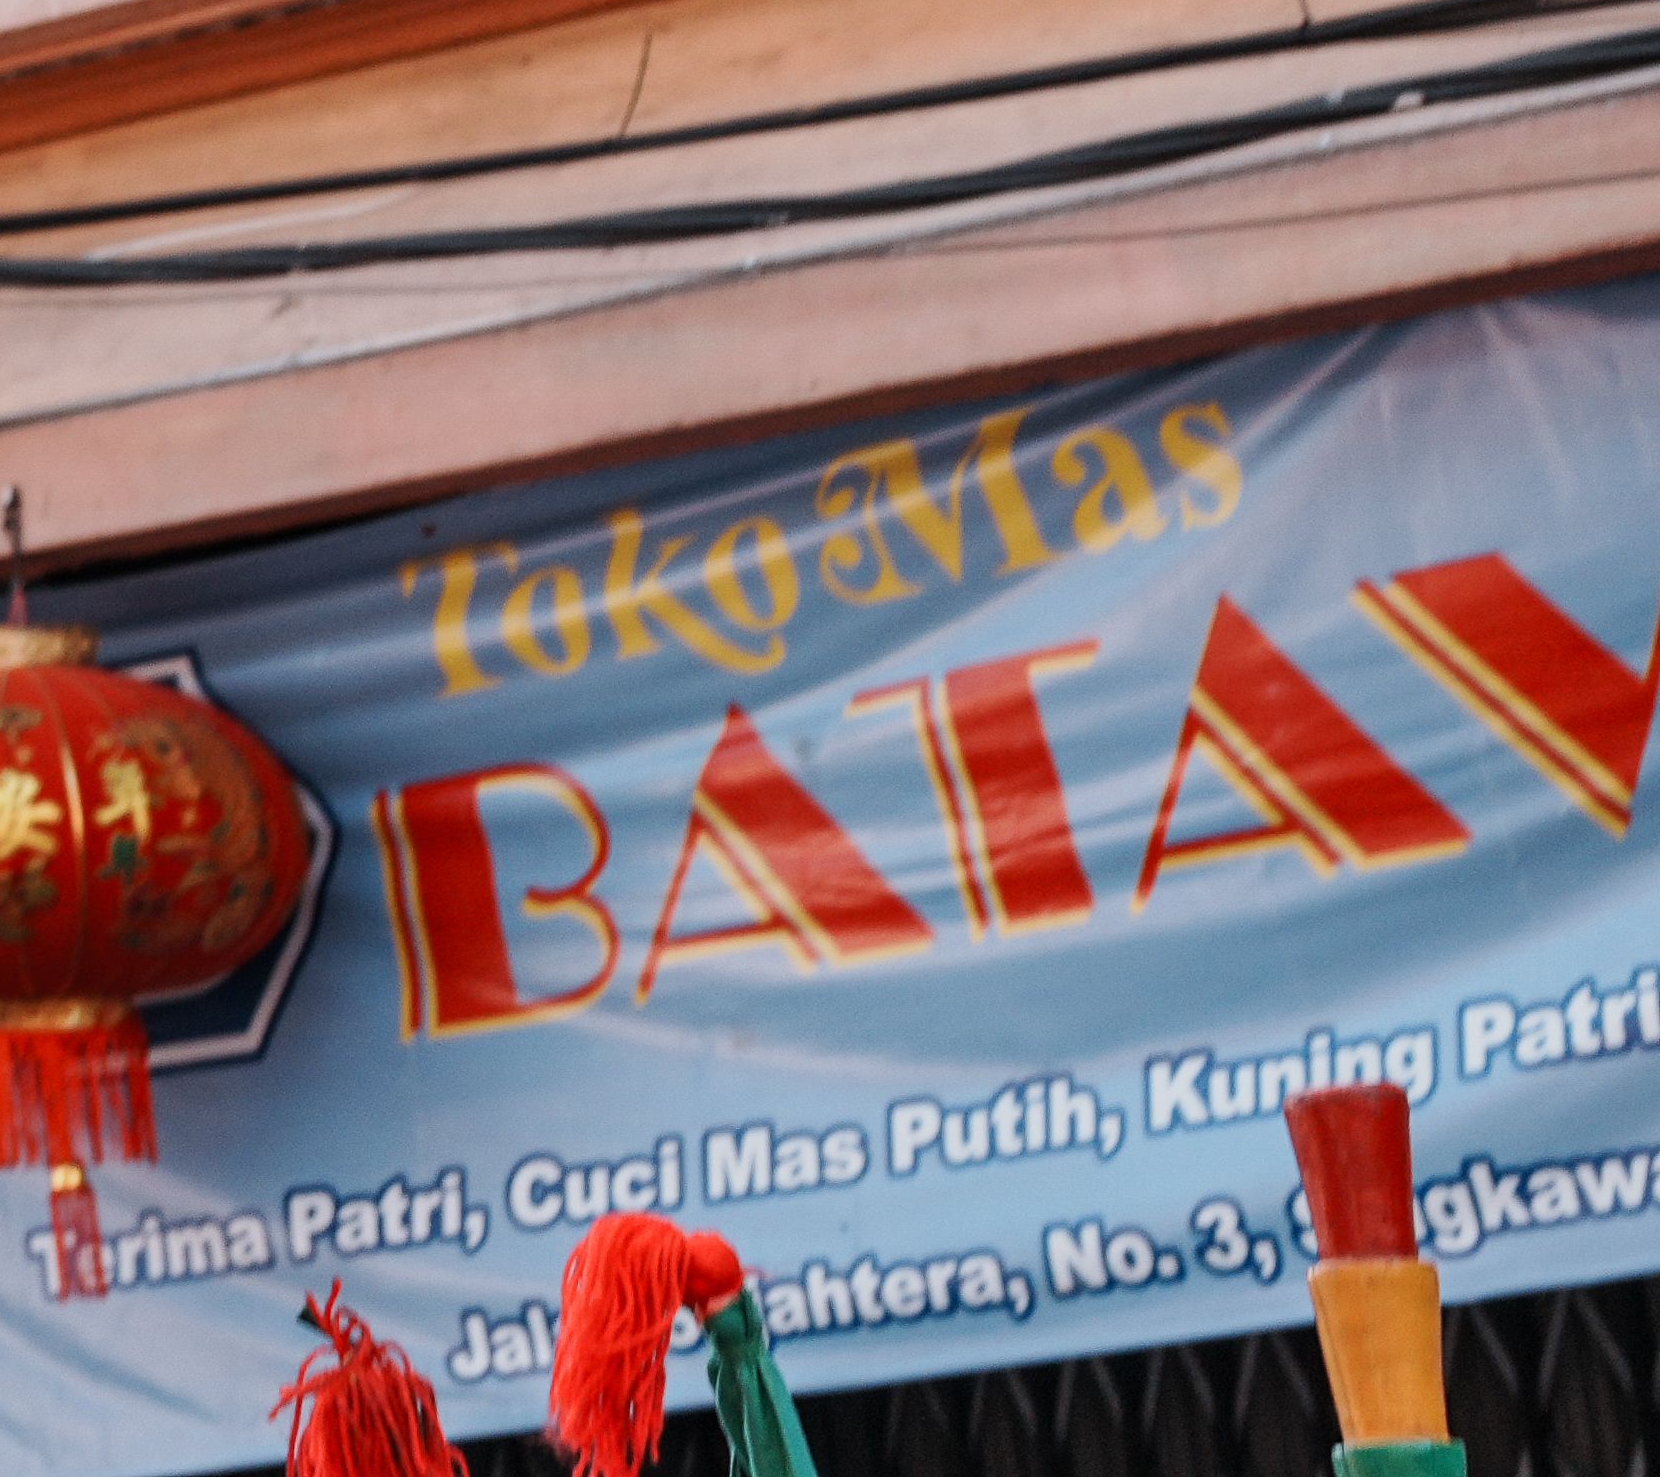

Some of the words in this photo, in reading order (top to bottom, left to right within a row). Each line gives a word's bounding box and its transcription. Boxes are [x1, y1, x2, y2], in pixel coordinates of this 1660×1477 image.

[396, 505, 801, 701] Toko
[816, 397, 1246, 608] Mas
[287, 1167, 487, 1259] Patri,
[508, 1137, 682, 1229] Cuci
[705, 1122, 868, 1201] Mas
[888, 1073, 1124, 1175] Putih,
[1043, 1217, 1185, 1301] No.
[1193, 1195, 1280, 1282] 3,
